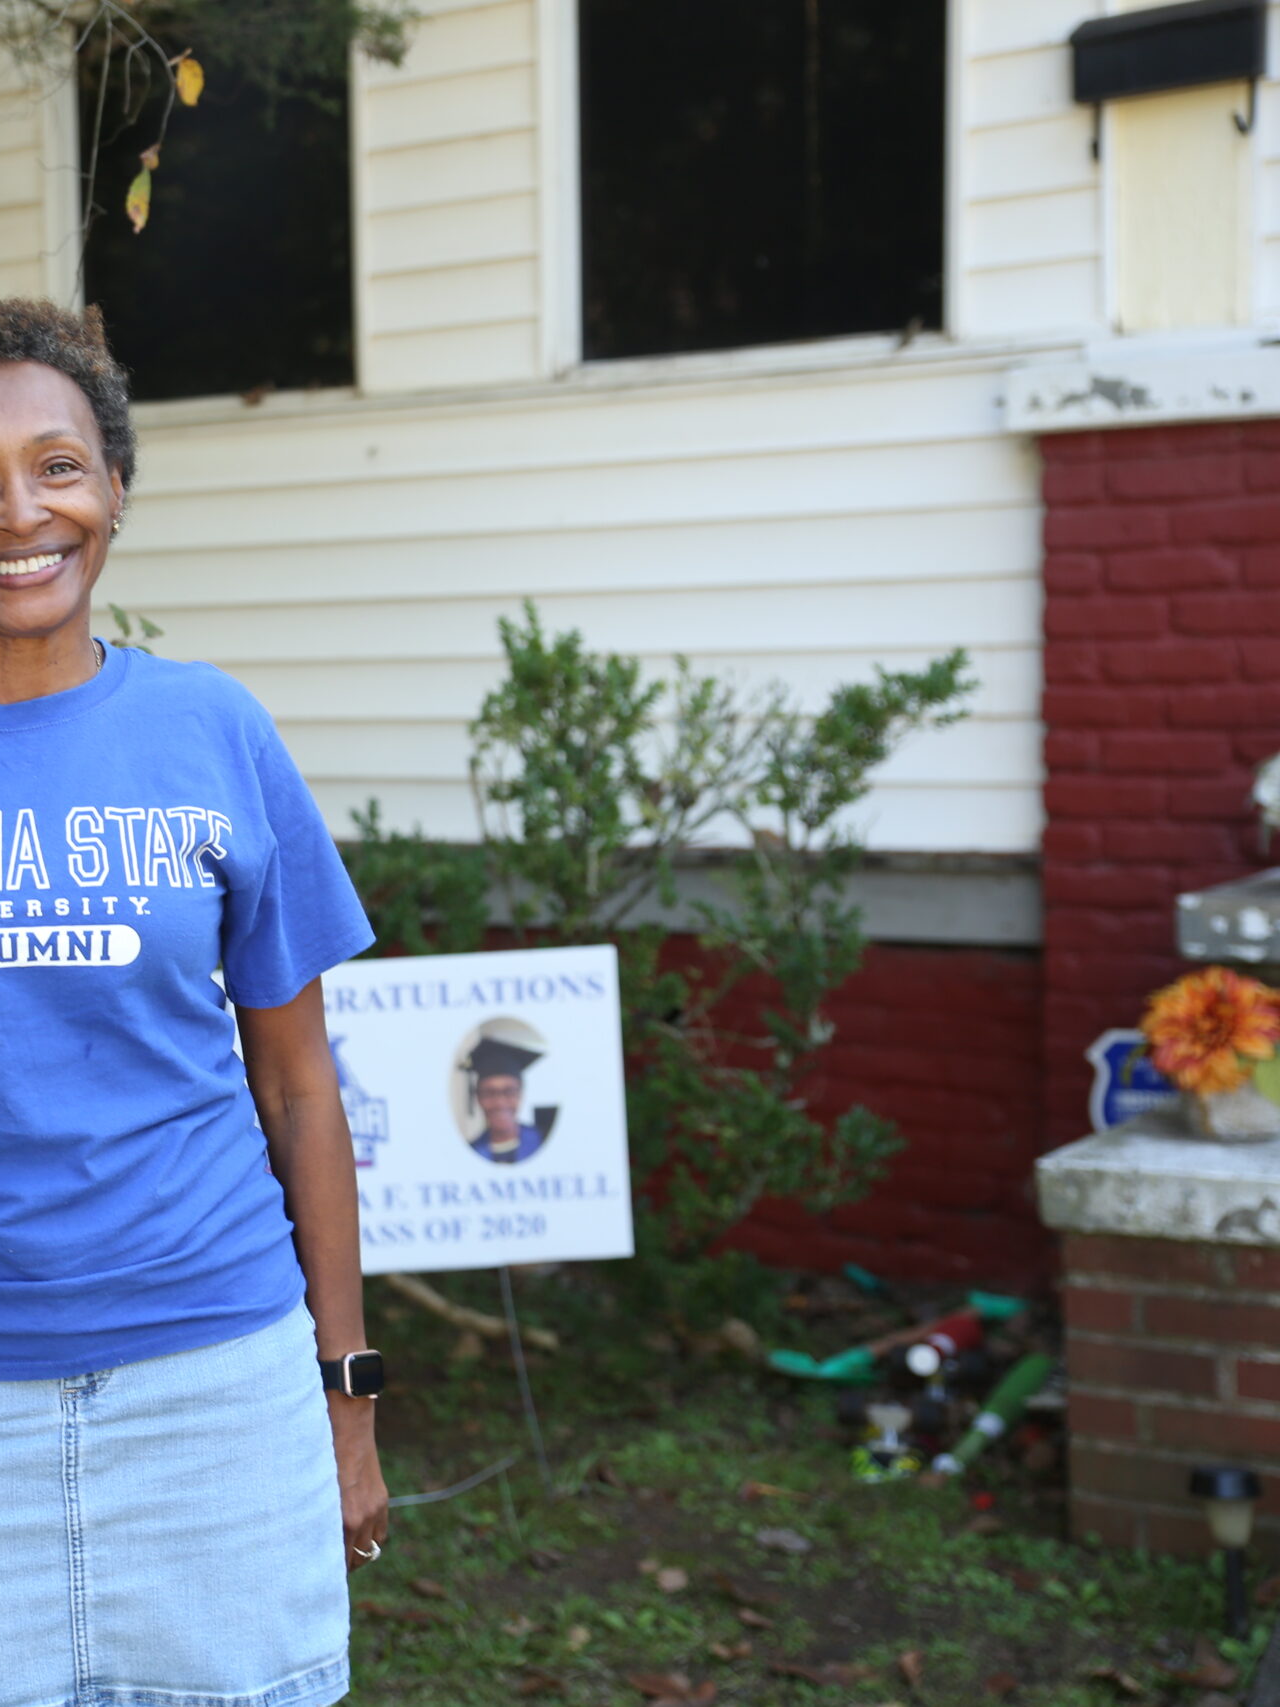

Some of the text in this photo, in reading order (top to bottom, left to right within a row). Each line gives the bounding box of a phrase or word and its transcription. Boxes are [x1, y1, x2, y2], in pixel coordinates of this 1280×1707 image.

[65, 805, 233, 889] STATE
[417, 1173, 619, 1207] TRAMMELL
[360, 1213, 548, 1246] ASS OF 2020
